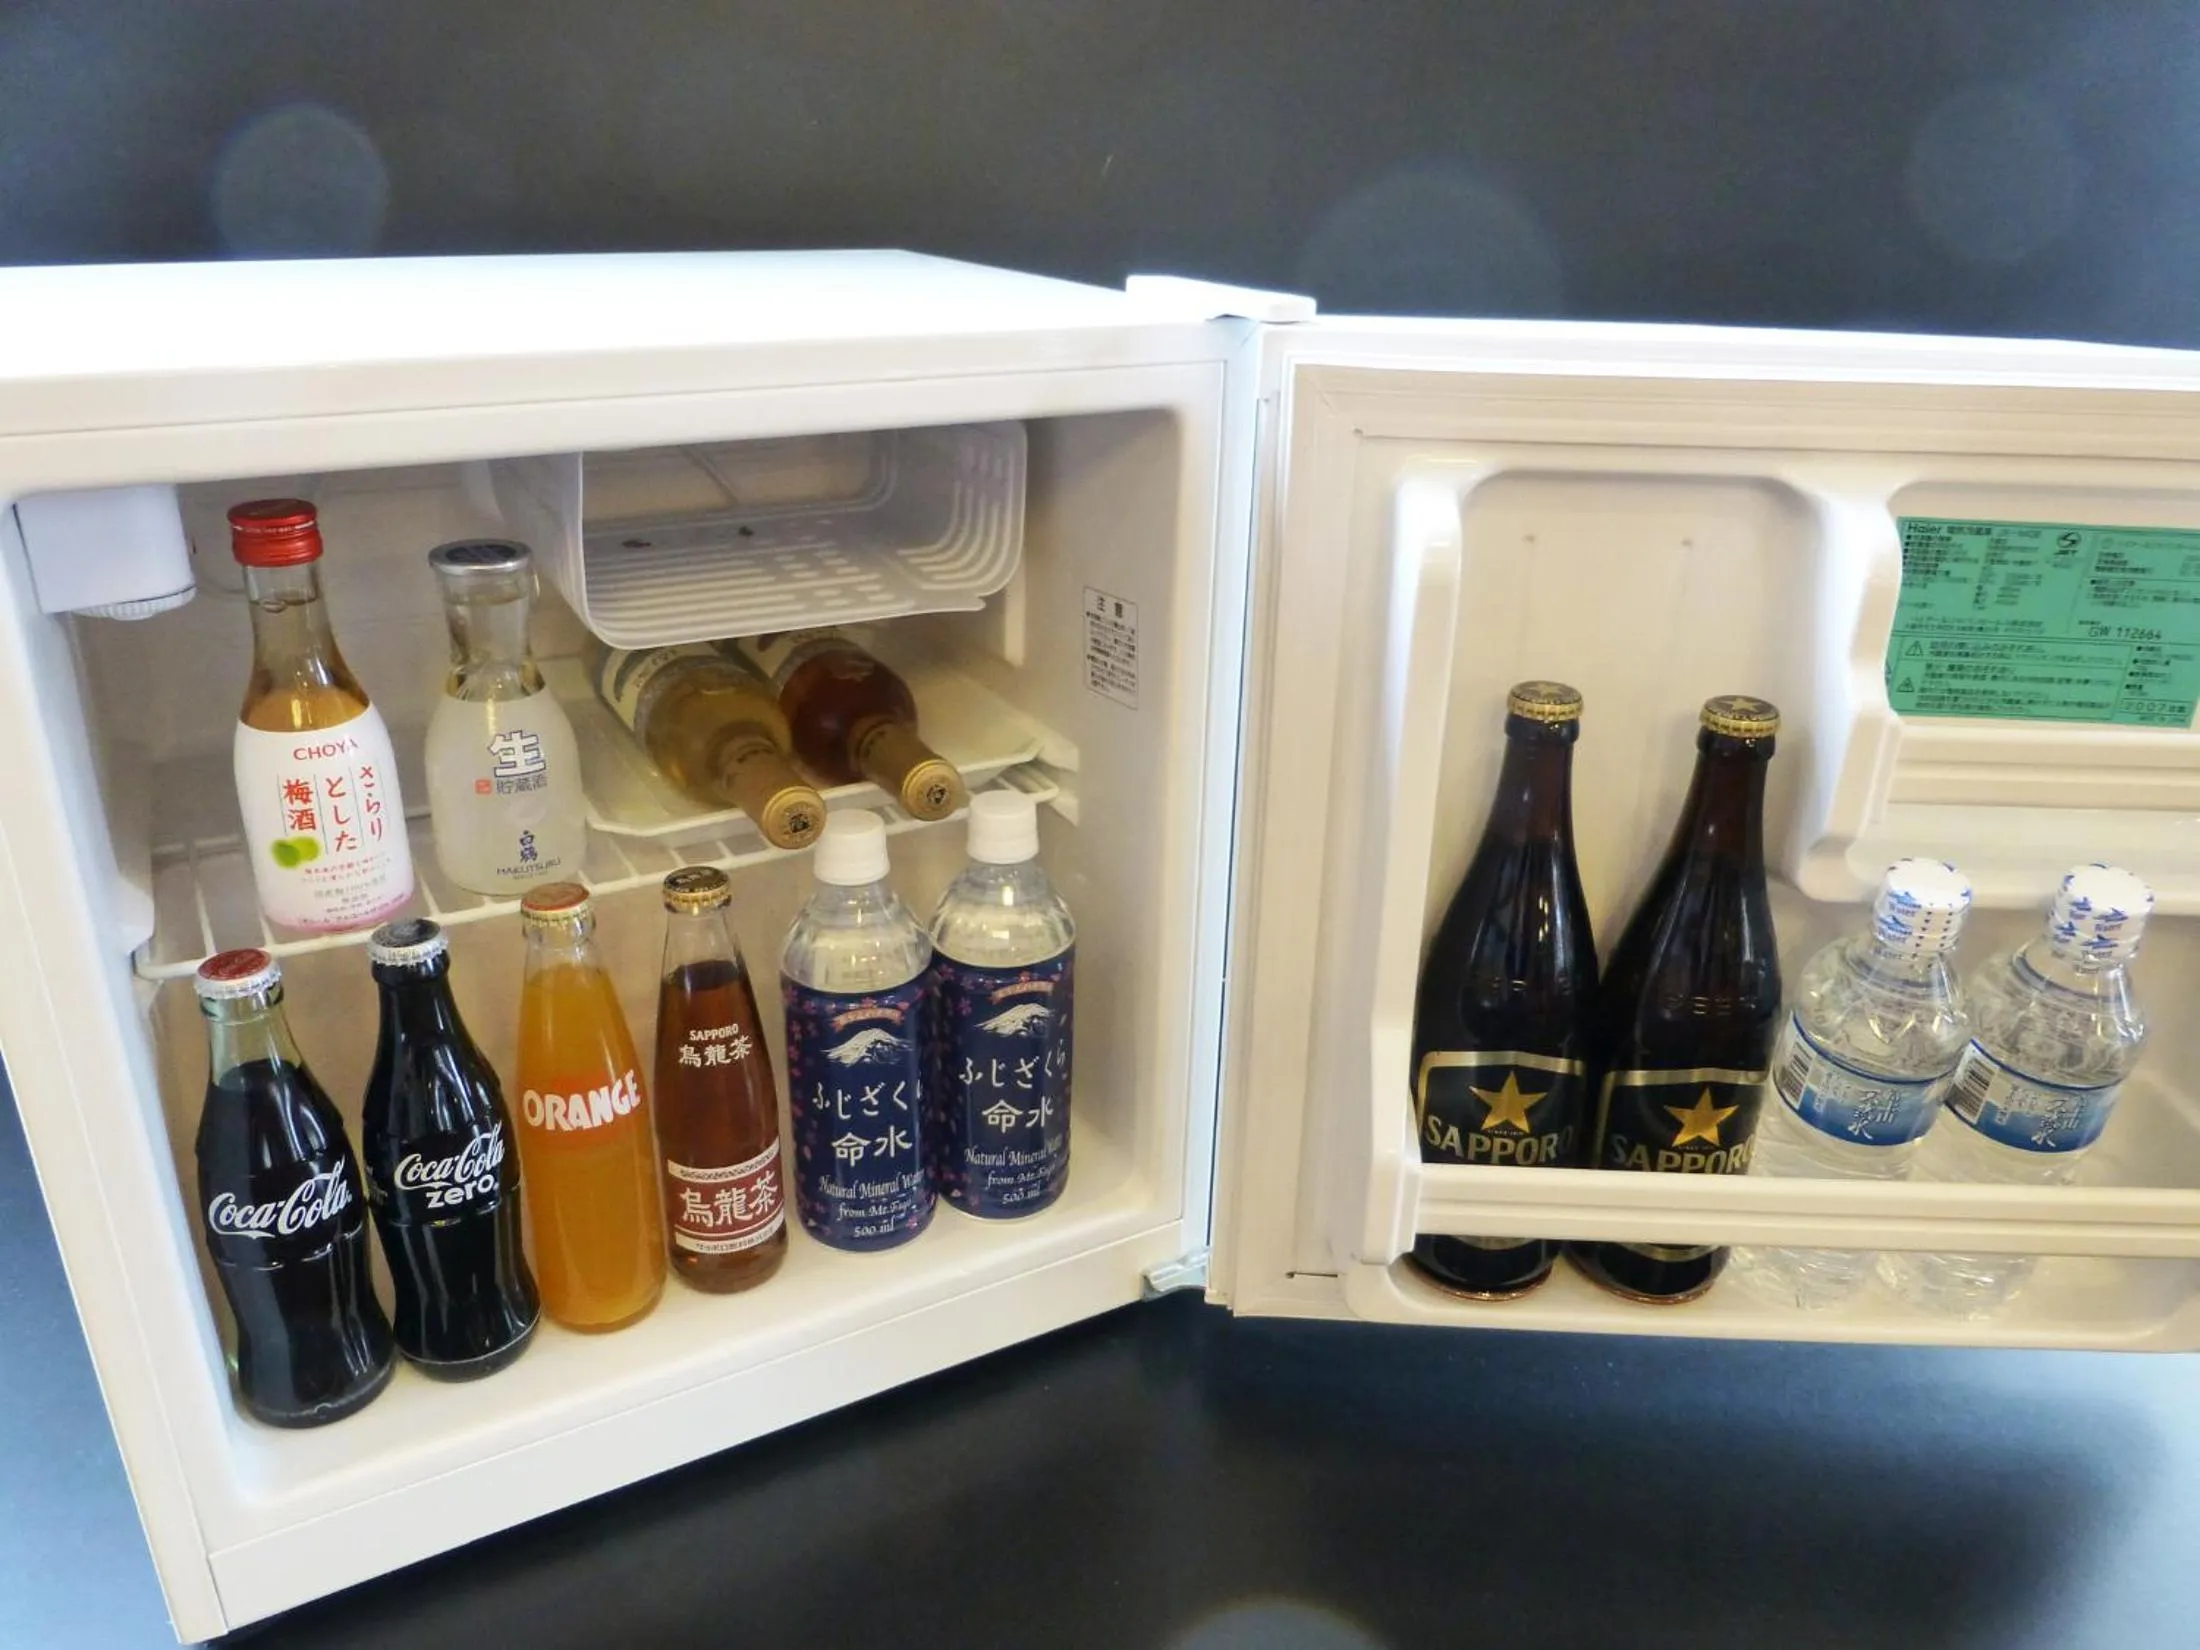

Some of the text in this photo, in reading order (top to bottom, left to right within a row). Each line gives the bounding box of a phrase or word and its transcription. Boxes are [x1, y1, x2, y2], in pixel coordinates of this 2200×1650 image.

[487, 730, 547, 778] 生
[282, 778, 317, 832] 梅酒
[325, 776, 358, 853] とした
[359, 765, 384, 842] さらり
[679, 1034, 753, 1068] 烏龍茶
[689, 1023, 739, 1042] SAPPORO
[522, 1069, 642, 1132] ORANGE
[981, 1096, 1054, 1134] 命水
[393, 1119, 506, 1191] Coca-Cola
[831, 1124, 913, 1167] 命水
[208, 1152, 353, 1239] Coca-Cola
[426, 1173, 496, 1210] zero
[680, 1169, 778, 1228] 烏龍茶
[985, 1169, 1015, 1191] from
[837, 1201, 865, 1221] from
